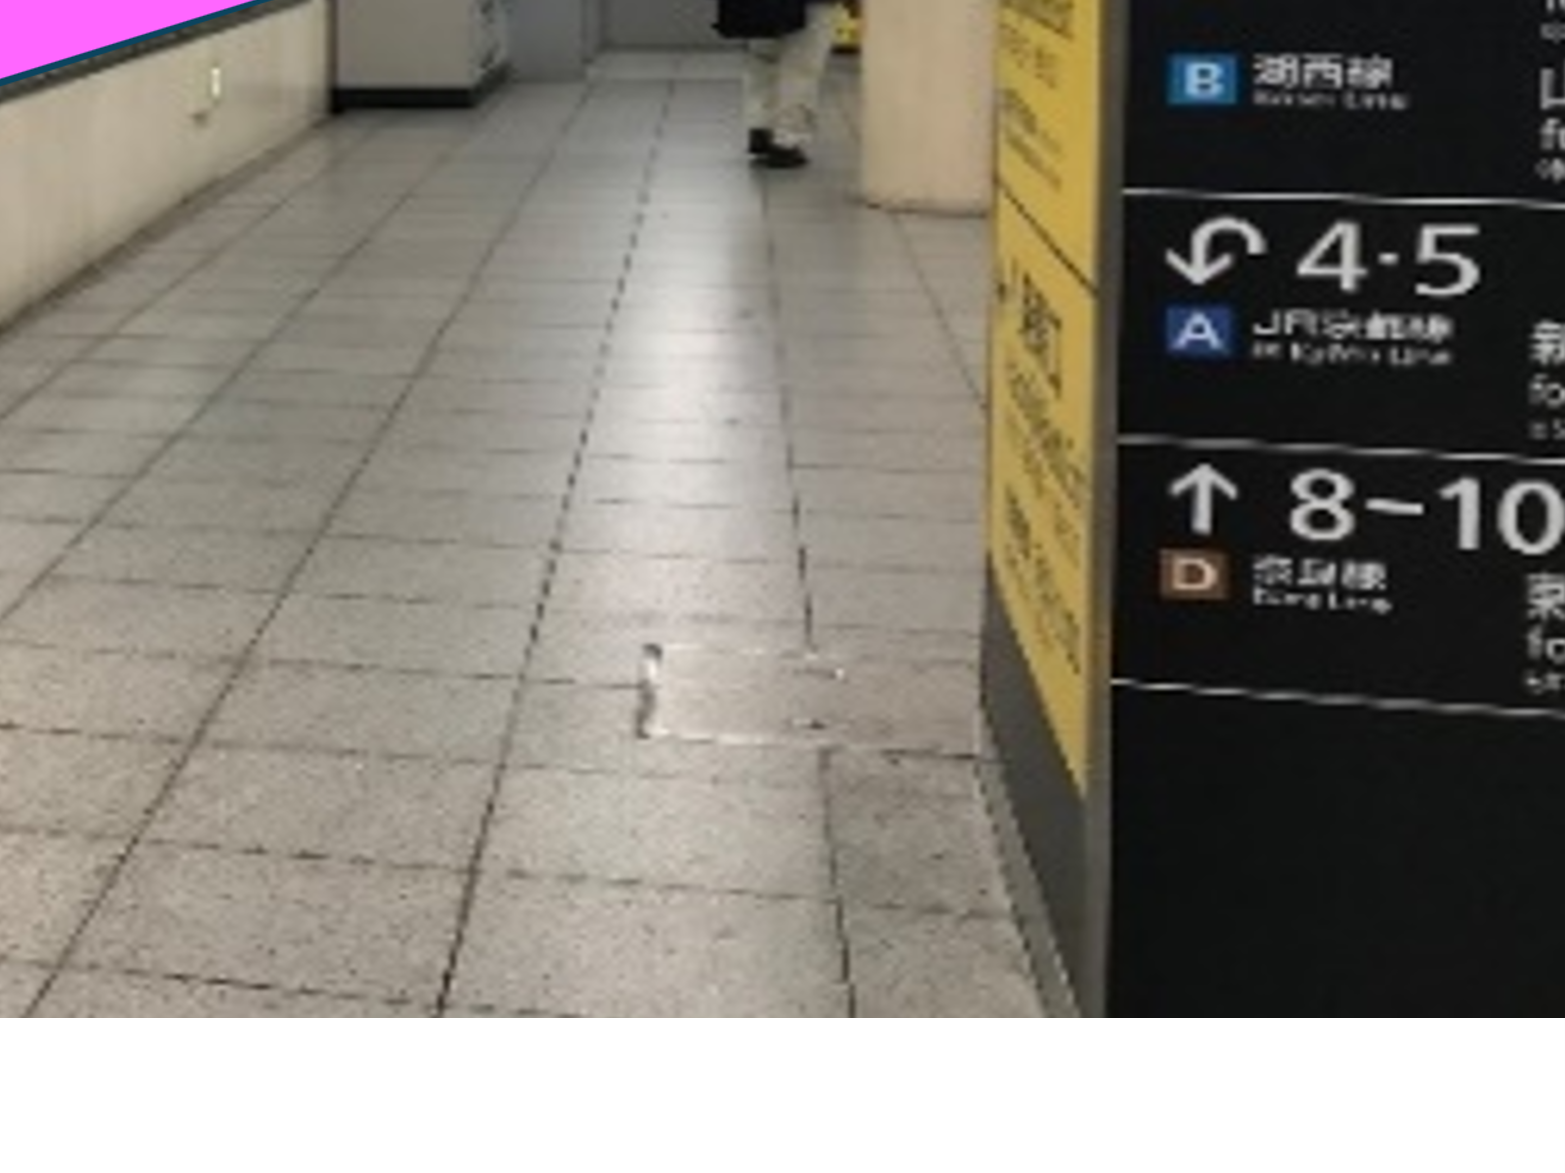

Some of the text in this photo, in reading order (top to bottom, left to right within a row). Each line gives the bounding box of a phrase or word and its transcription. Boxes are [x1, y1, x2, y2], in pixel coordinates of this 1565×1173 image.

[1184, 61, 1224, 97] B
[1171, 313, 1223, 349] A
[1171, 558, 1217, 591] D
